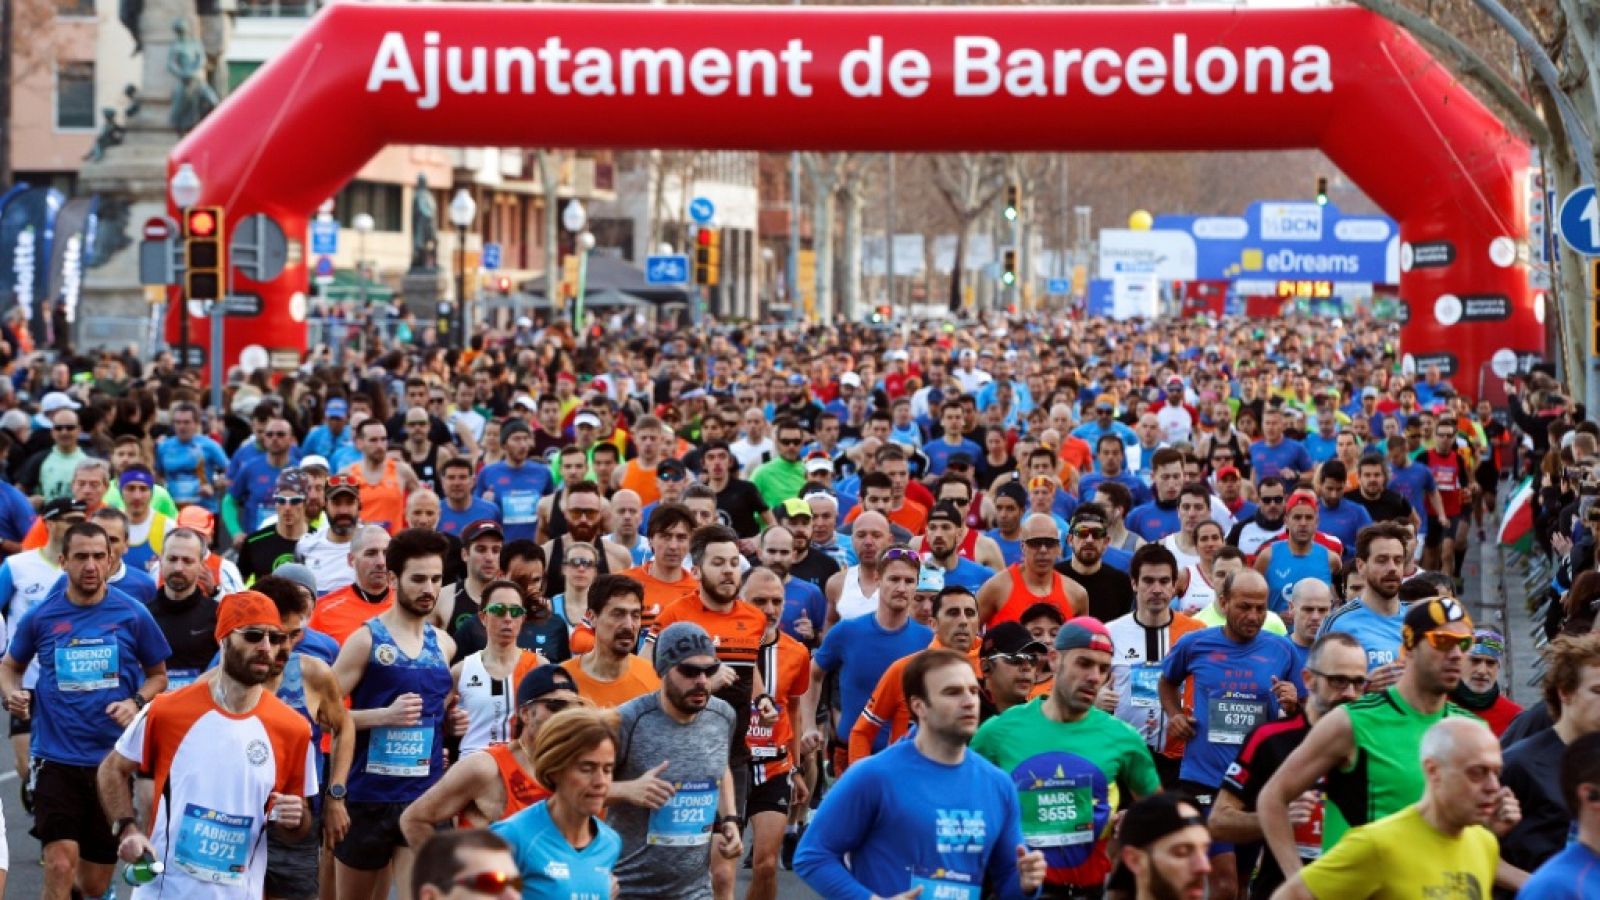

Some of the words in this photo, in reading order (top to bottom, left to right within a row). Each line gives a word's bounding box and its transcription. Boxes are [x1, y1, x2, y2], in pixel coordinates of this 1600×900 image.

[366, 32, 813, 108] Ajuntament
[840, 36, 930, 98] de
[954, 33, 1334, 97] Barcelona
[1266, 248, 1359, 273] eDreams
[65, 647, 112, 660] LORENZO
[1368, 650, 1393, 664] PRO
[1218, 702, 1229, 712] EL
[1224, 713, 1256, 726] 6378
[386, 729, 424, 741] MIGUEL
[385, 742, 424, 755] 12664
[1037, 791, 1075, 806] MARC
[671, 808, 705, 823] 1921
[1037, 804, 1077, 822] 3655
[194, 822, 246, 844] FABRIZIO
[198, 839, 238, 859] 1971
